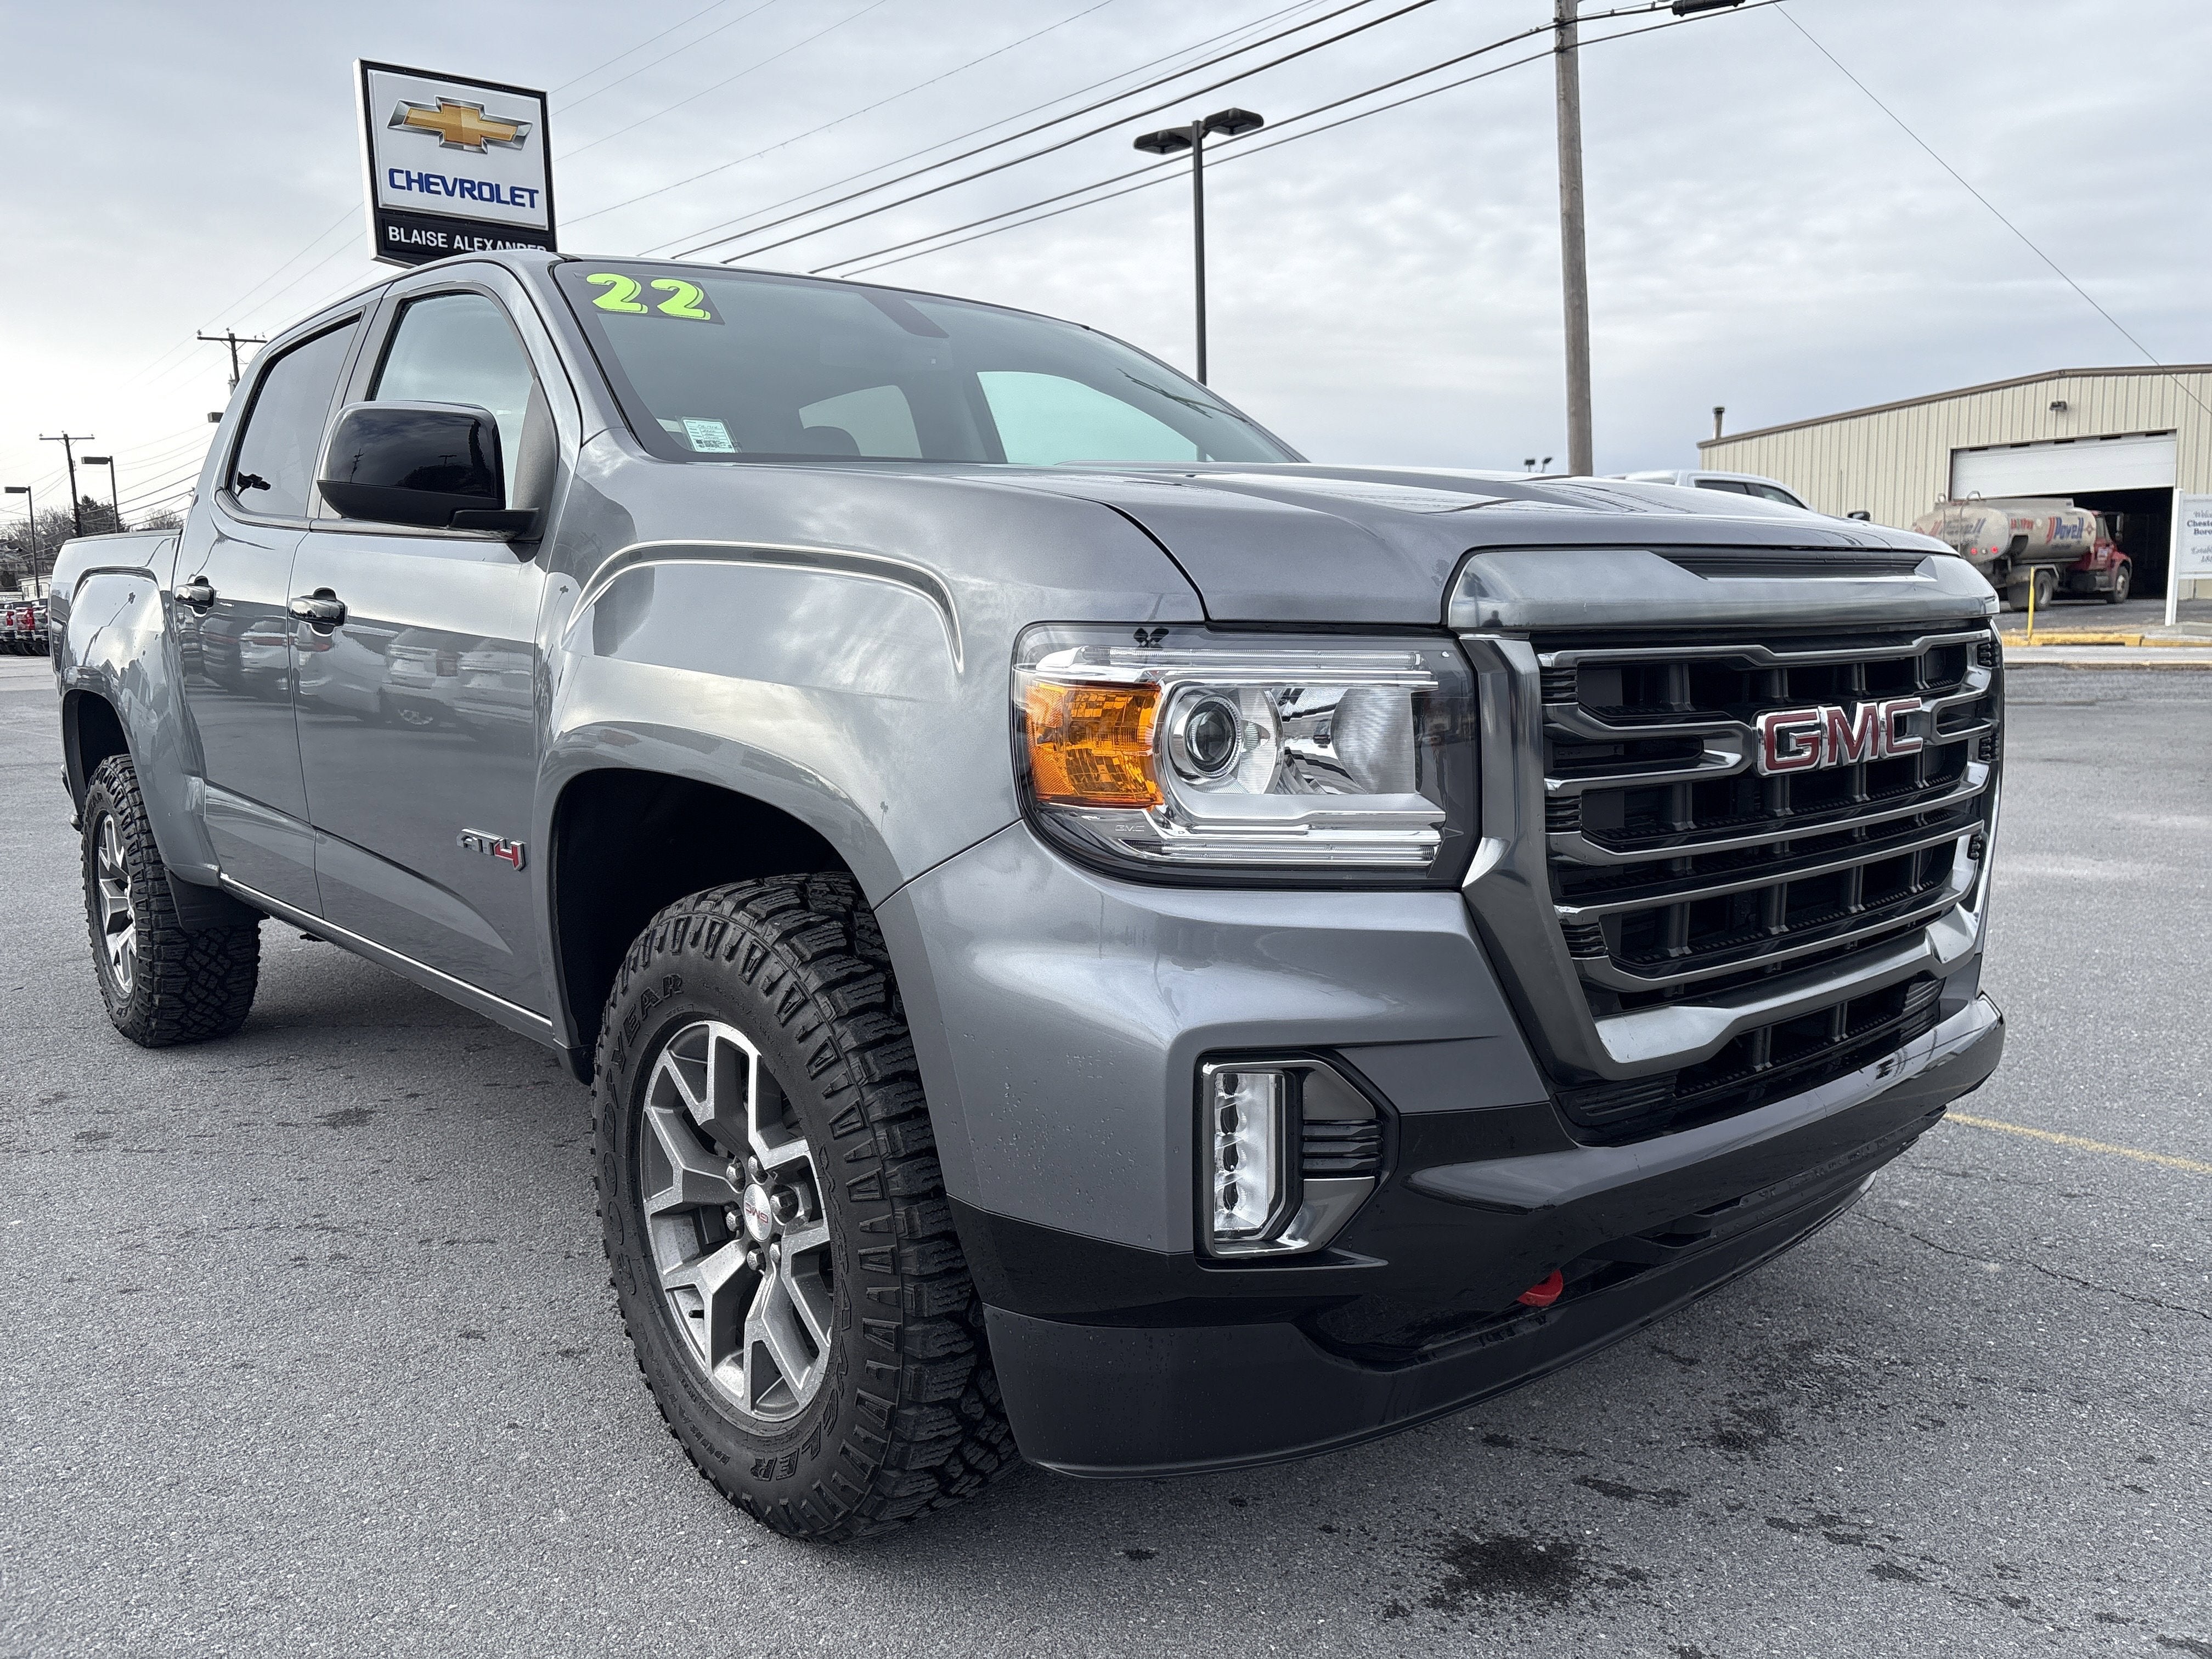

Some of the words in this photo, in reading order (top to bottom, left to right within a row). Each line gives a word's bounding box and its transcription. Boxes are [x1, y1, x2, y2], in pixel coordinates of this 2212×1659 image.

[388, 168, 539, 208] CHEVROLET
[387, 225, 449, 249] BLAISE
[586, 273, 711, 321] 22
[1756, 697, 1923, 776] GMC
[456, 827, 526, 872] AT4
[746, 1201, 769, 1224] GMC
